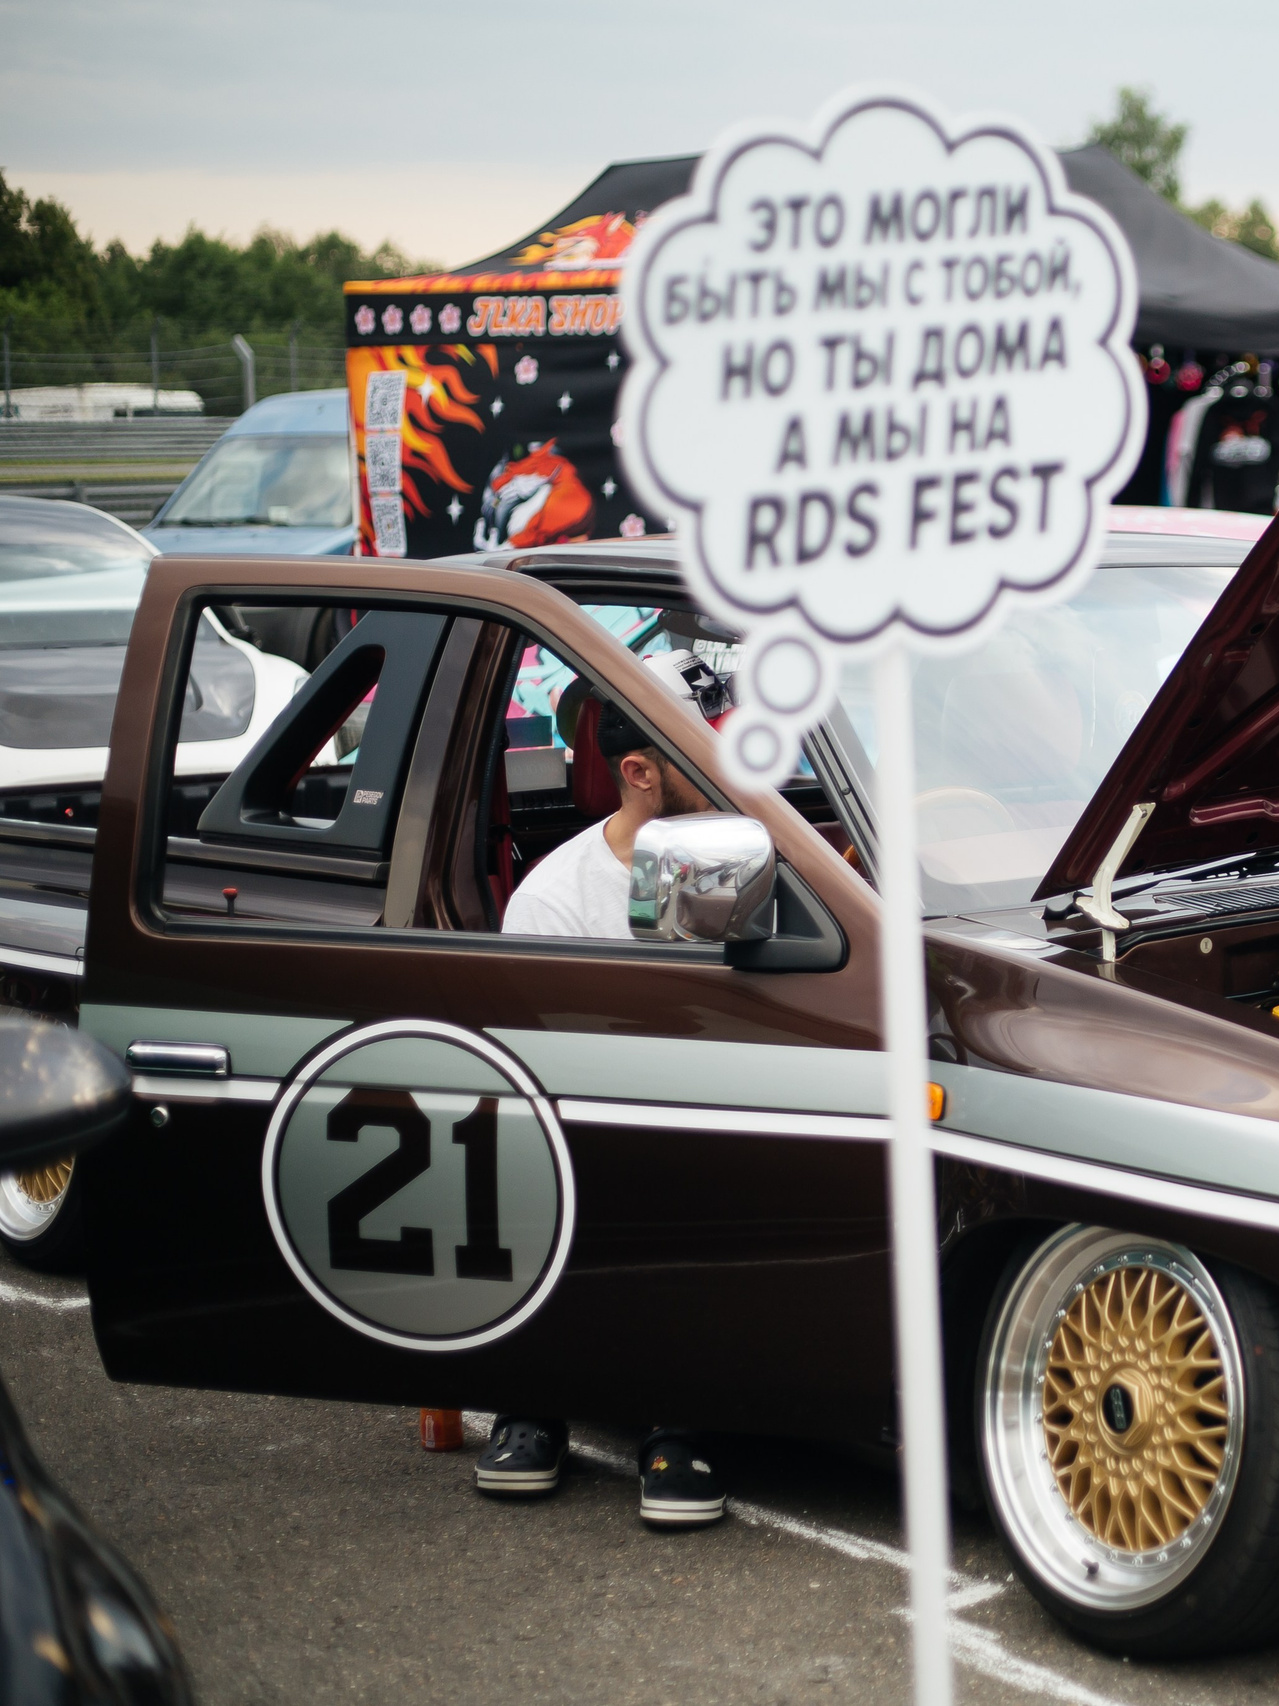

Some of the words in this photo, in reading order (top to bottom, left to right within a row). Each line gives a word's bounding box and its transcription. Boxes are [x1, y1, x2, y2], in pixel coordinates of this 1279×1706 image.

[747, 193, 844, 253] ЭТО
[865, 184, 1030, 246] МОГЛИ
[663, 270, 797, 326] БЫТЬ
[813, 260, 889, 312] МЫ
[905, 259, 925, 306] С
[941, 237, 1082, 301] ТОБОЙ,
[721, 338, 795, 400] НО
[823, 333, 893, 392] ТЫ
[912, 316, 1067, 389] ДОМА
[775, 413, 807, 475] А
[833, 403, 926, 467] МЫ
[948, 394, 1012, 453] НА
[743, 482, 881, 572] RDS
[909, 461, 1064, 550] FEST
[326, 1087, 513, 1282] 21
